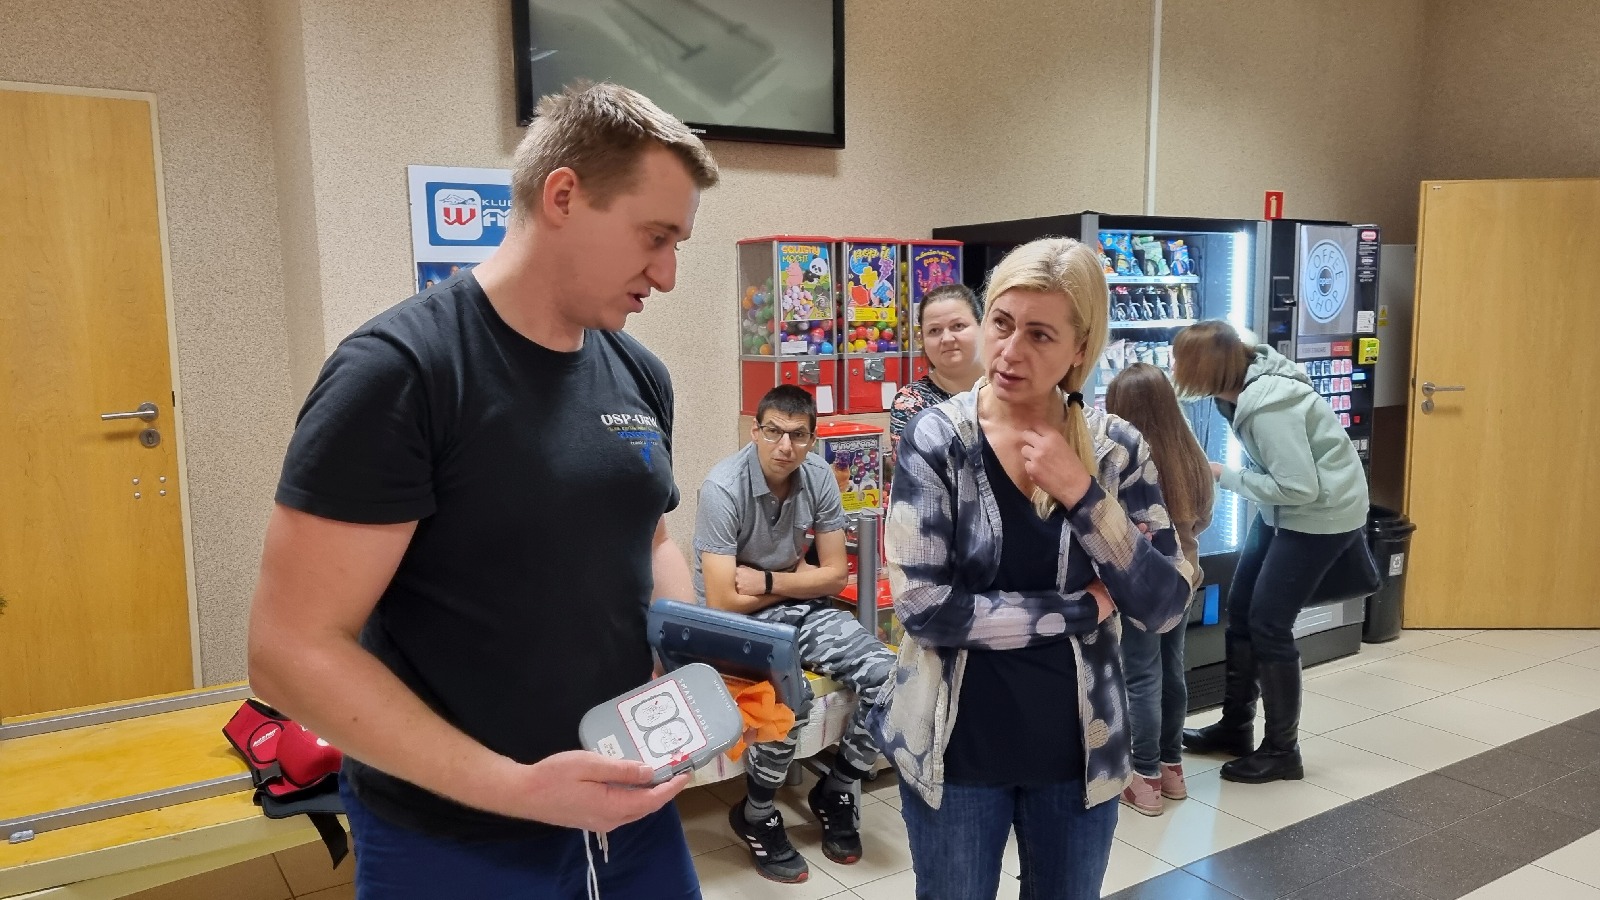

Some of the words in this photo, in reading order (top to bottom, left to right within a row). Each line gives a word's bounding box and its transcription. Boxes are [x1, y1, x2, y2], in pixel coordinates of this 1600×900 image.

[1308, 248, 1345, 281] COFFEE
[1309, 290, 1339, 313] SHOP
[678, 678, 697, 706] SMART
[694, 708, 710, 731] PADS
